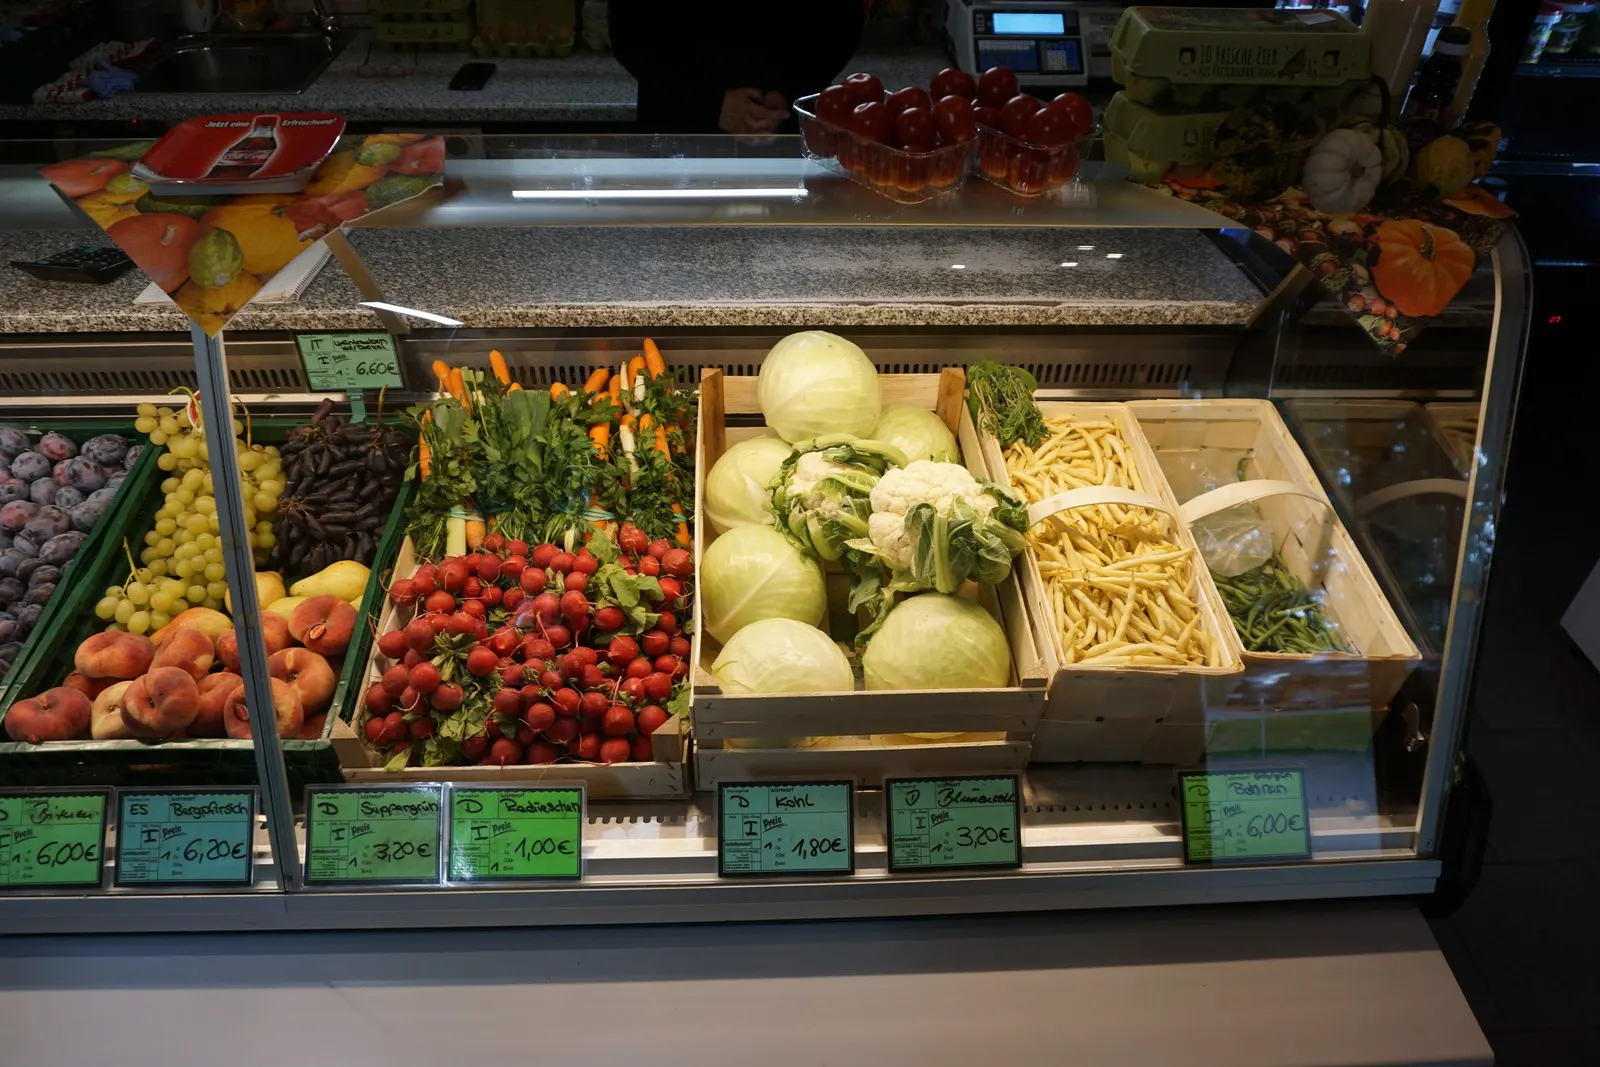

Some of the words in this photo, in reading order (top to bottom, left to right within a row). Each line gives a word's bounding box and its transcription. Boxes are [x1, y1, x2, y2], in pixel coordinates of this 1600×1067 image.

[1216, 45, 1253, 66] FRISCHE
[1257, 46, 1277, 65] EIER
[281, 117, 337, 127] Erfrischung!
[310, 339, 323, 351] IT
[356, 361, 400, 376] 6,60€
[317, 801, 339, 815] D
[456, 799, 483, 813] D
[775, 794, 814, 808] Kohl
[130, 803, 148, 815] ES
[763, 815, 782, 829] Preis
[931, 811, 949, 824] Preis
[162, 825, 182, 837] Preis
[351, 823, 371, 836] Preis
[492, 821, 512, 834] Preis
[1246, 812, 1305, 839] 6,00€
[14, 828, 34, 841] Preis
[956, 826, 1014, 849] 3,20€
[37, 841, 100, 868] 6,00€
[183, 839, 247, 864] 6,20€
[373, 841, 432, 863] 3,20€
[514, 837, 575, 862] 1,00€
[791, 838, 847, 860] 1,80€
